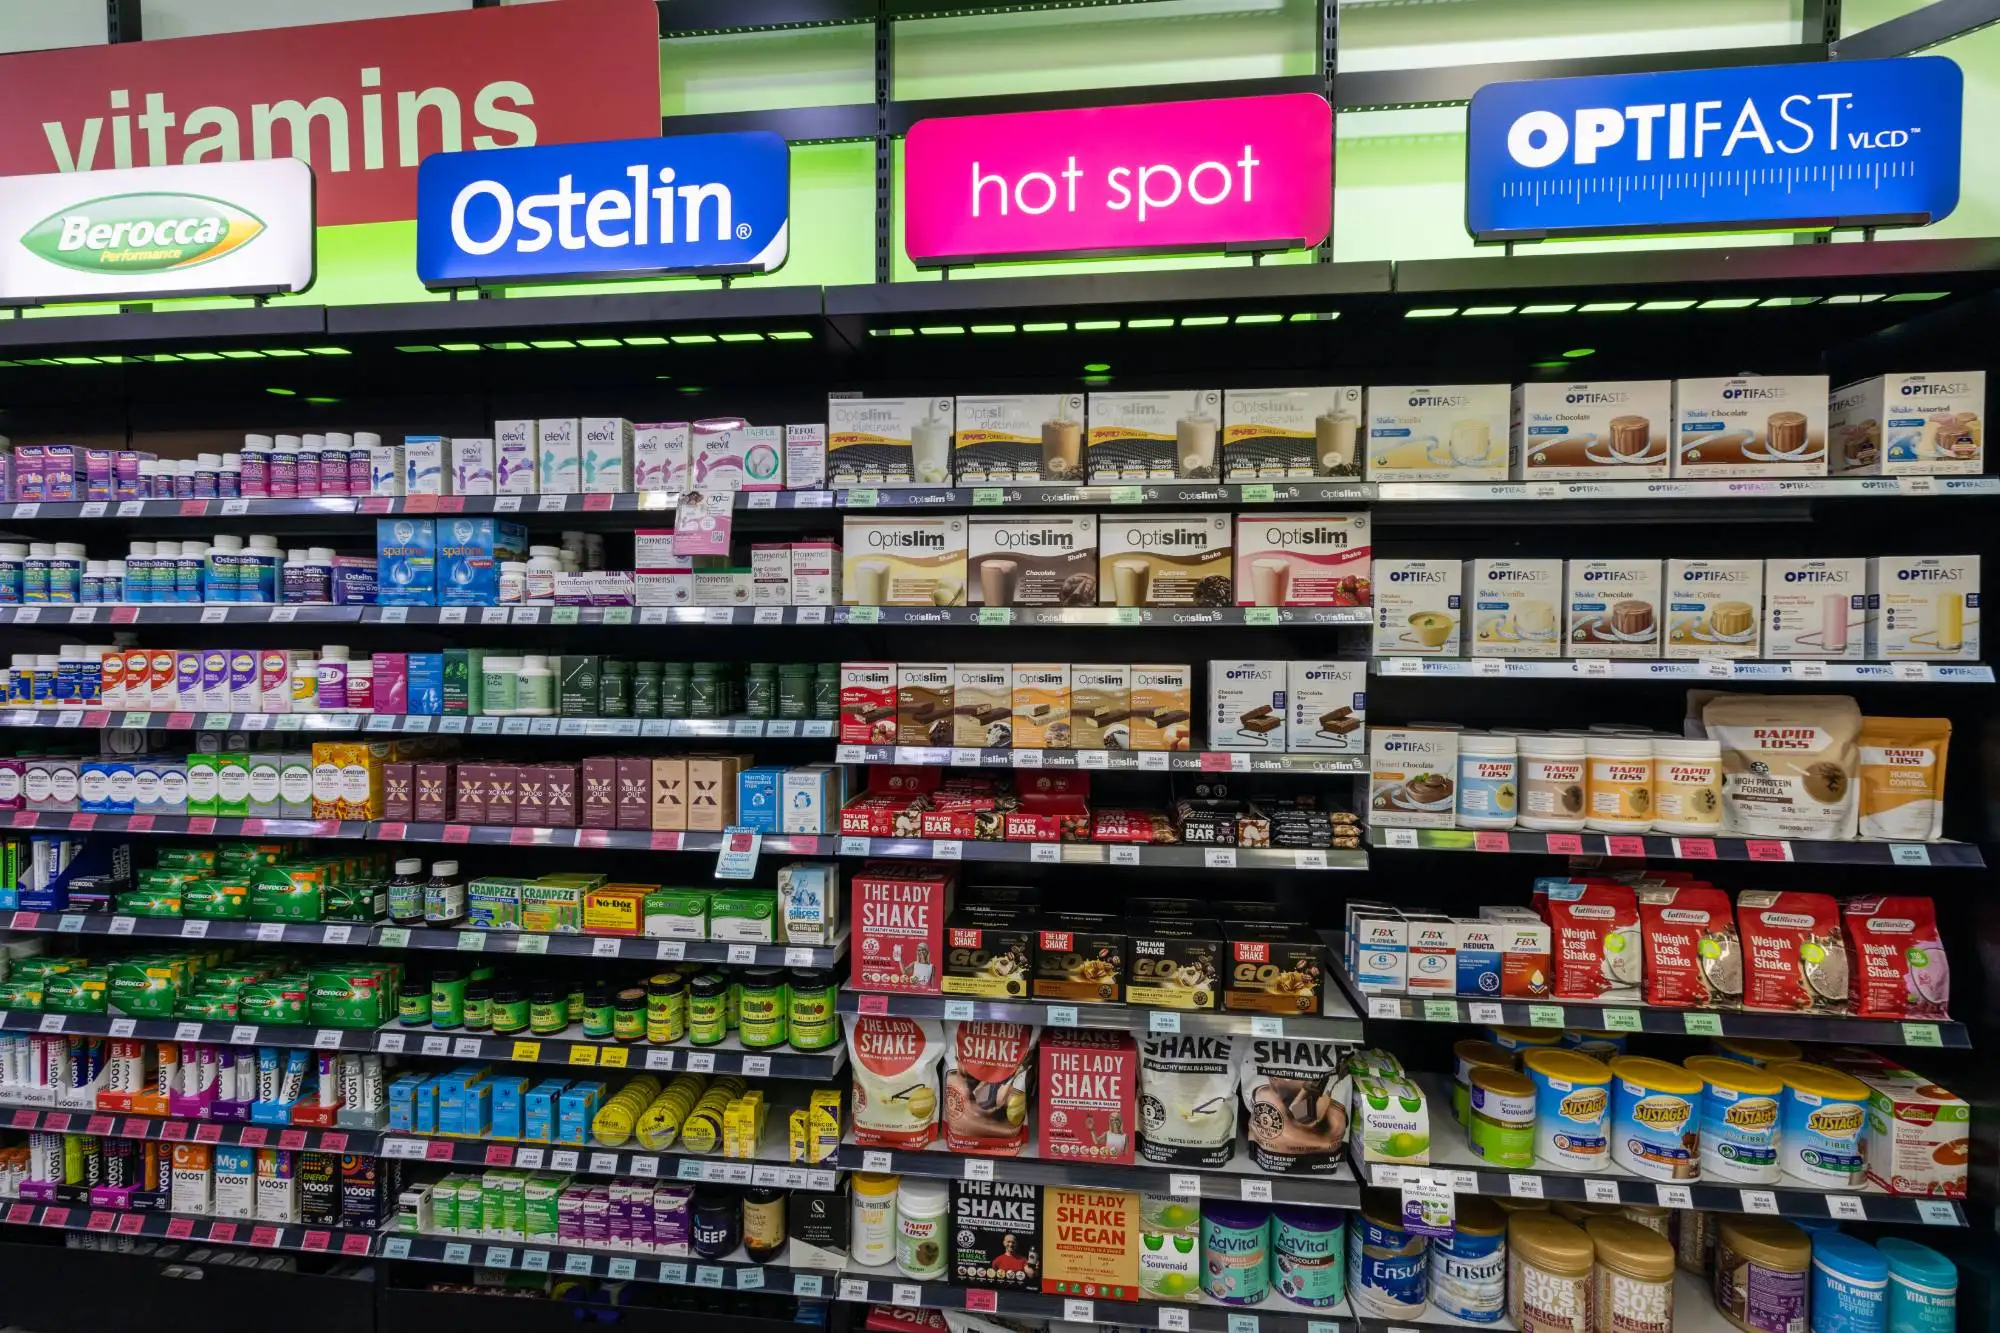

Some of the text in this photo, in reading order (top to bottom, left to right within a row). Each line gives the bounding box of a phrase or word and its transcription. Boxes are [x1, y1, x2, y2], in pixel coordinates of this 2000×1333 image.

[42, 66, 538, 173] vitamins
[1507, 92, 1853, 168] OPTIFAST
[972, 145, 1260, 222] hot spot
[58, 214, 227, 250] Berocca
[99, 246, 183, 263] Performance
[1556, 414, 1590, 422] Chocolate
[502, 431, 526, 442] elevit
[544, 431, 571, 442] elevit
[587, 430, 614, 442] elevit
[638, 439, 657, 449] elevit
[706, 439, 729, 449] elevit
[868, 530, 945, 550] Optislim
[995, 529, 1074, 549] Optislim
[1127, 528, 1208, 549] Optislim
[1266, 527, 1348, 548] Optislim
[1067, 552, 1087, 562] Shake
[1201, 551, 1222, 561] Shake
[1342, 550, 1362, 560] Shake
[637, 576, 675, 584] Promensil
[696, 575, 734, 584] Promensil
[1390, 571, 1447, 582] OPTIFAST
[1785, 570, 1849, 583] OPTIFAST
[1897, 568, 1963, 581] OPTIFAST
[1598, 591, 1633, 599] Chocolate
[848, 672, 889, 683] Optislim
[905, 672, 947, 683] Optislim
[1020, 673, 1063, 684] Optislim
[1138, 674, 1183, 686] Optislim
[1226, 670, 1272, 680] OPTIFAST
[1306, 671, 1352, 681] OPTIFAST
[1753, 728, 1815, 740] RAPID
[1761, 739, 1809, 749] LOSS
[1884, 749, 1924, 758] RAPID
[1889, 757, 1921, 766] LOSS
[1543, 765, 1579, 773] RAPID
[1670, 766, 1711, 775] RAPID
[1889, 770, 1924, 779] HUNGER
[1546, 772, 1575, 780] LOSS
[1672, 774, 1706, 783] LOSS
[1756, 778, 1792, 788] PROTEIN
[1889, 778, 1927, 788] CONTROL
[1741, 786, 1784, 796] FORMULA
[843, 819, 869, 830] BAR
[1009, 824, 1036, 835] BAR
[1185, 829, 1214, 840] BAR
[258, 883, 293, 892] Berocca
[469, 885, 516, 897] CRAMPEZE
[524, 887, 574, 900] CRAMPEZE
[863, 884, 931, 903] THE LADY
[863, 902, 929, 928] SHAKE
[955, 929, 976, 938] THE LADY
[1372, 928, 1394, 937] FBX
[1467, 932, 1492, 942] FBX
[1562, 928, 1596, 940] Weight
[954, 937, 977, 947] SHAKE
[1045, 940, 1068, 950] SHAKE
[1136, 940, 1165, 949] THE MAN
[1514, 937, 1538, 946] FBX
[1563, 939, 1586, 950] Loss
[1652, 932, 1690, 946] Weight
[1136, 946, 1165, 955] SHAKE
[1463, 942, 1495, 950] REDUCTA
[1654, 943, 1680, 955] Loss
[1863, 942, 1898, 957] Weight
[1239, 951, 1264, 961] SHAKE
[1563, 949, 1596, 961] Shake
[1655, 954, 1691, 968] Shake
[1866, 955, 1888, 966] Loss
[1133, 959, 1178, 977] GO
[1234, 963, 1280, 982] GO
[1866, 966, 1900, 979] Shake
[115, 979, 145, 988] Berocca
[862, 1019, 915, 1034] THE LADY
[861, 1035, 916, 1055] SHAKE
[963, 1038, 1018, 1063] SHAKE
[1144, 1036, 1232, 1060] SHAKE
[1051, 1053, 1123, 1074] THE LADY
[1051, 1074, 1121, 1100] SHAKE
[1635, 1105, 1690, 1123] SUSTAGEN
[1372, 1119, 1417, 1131] Souvenaid
[218, 1155, 237, 1170] Mg
[958, 1180, 1035, 1198] THE MAN
[1057, 1193, 1125, 1208] THE LADY
[957, 1198, 1035, 1221] SHAKE
[1057, 1207, 1126, 1227] SHAKE
[903, 1220, 933, 1230] RAPID
[1058, 1226, 1126, 1245] VEGAN
[1208, 1234, 1258, 1253] AdVital
[1277, 1233, 1329, 1253] AdVital
[1146, 1259, 1188, 1271] Souvenaid
[1286, 1253, 1321, 1265] CHOCOLATE
[1524, 1267, 1574, 1290] OVER
[1827, 1278, 1846, 1293] VITAL
[1524, 1281, 1574, 1307] 50'S
[1524, 1302, 1574, 1325] WEIGHT
[1839, 1301, 1874, 1317] PEPTIDES
